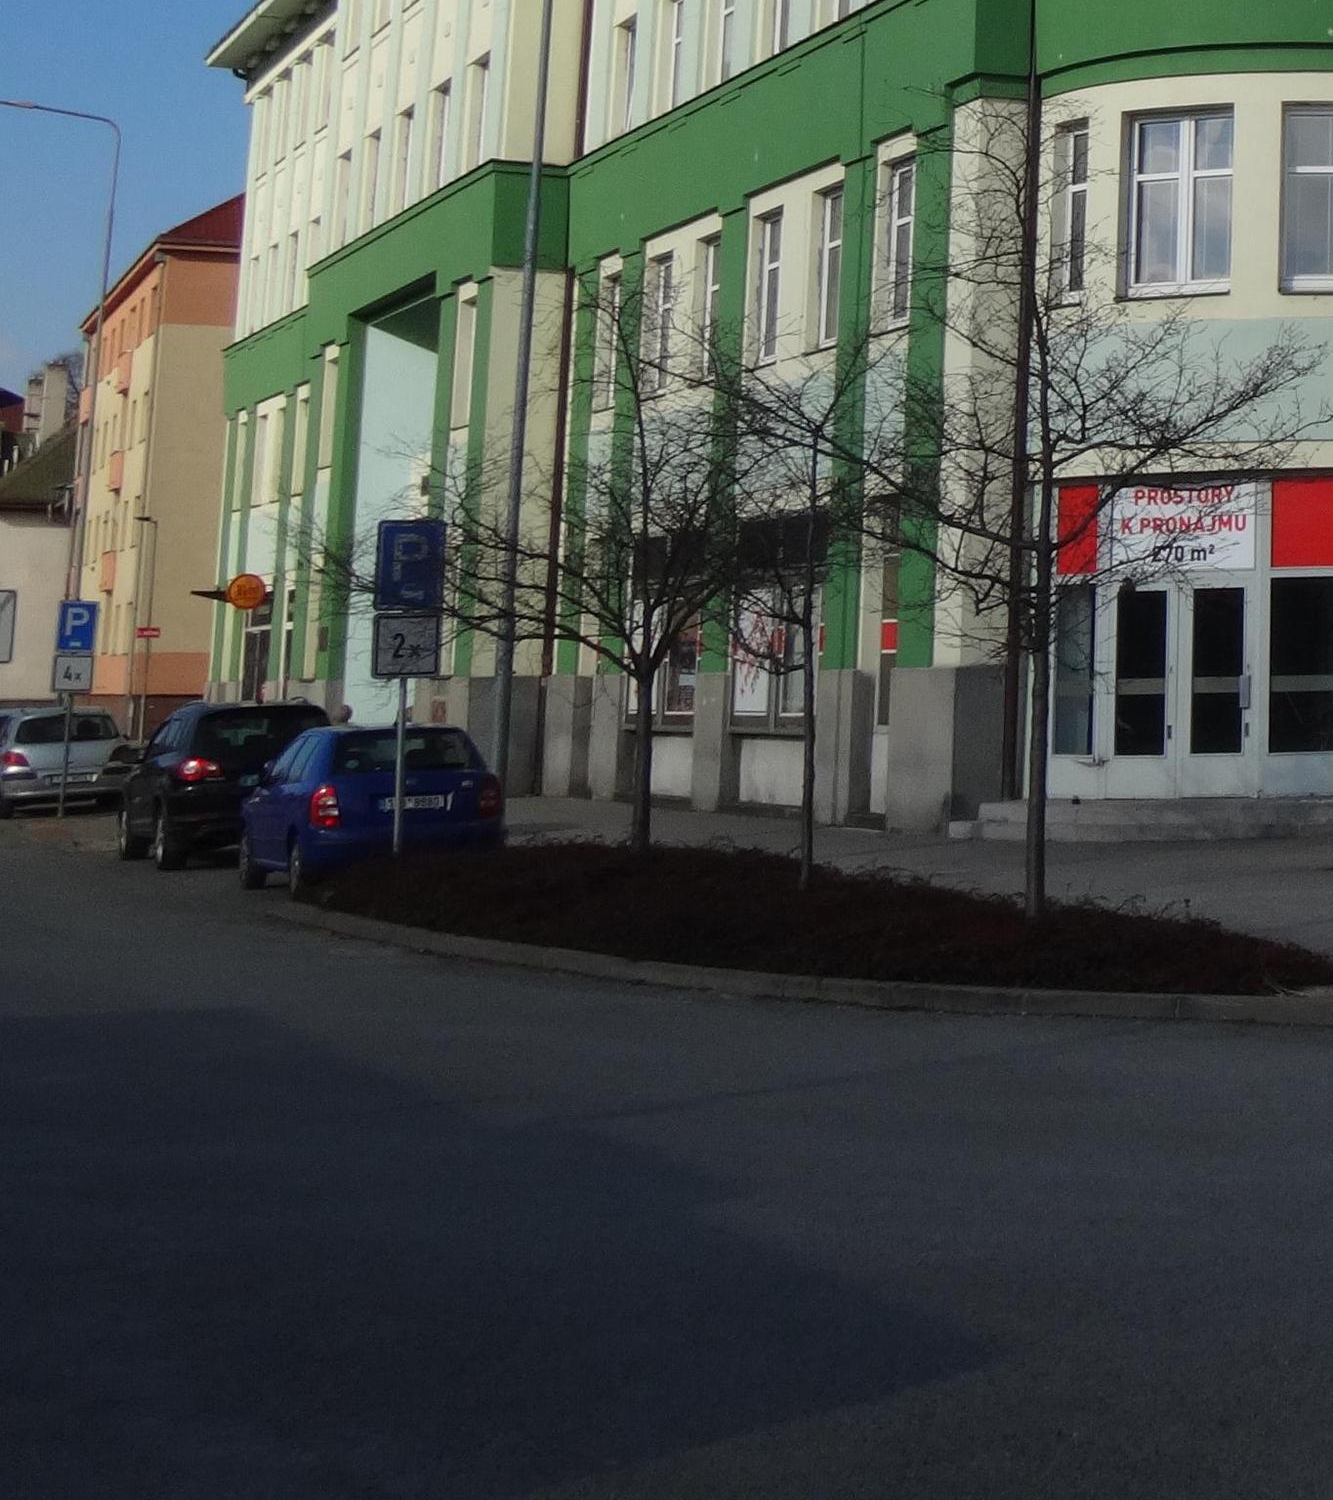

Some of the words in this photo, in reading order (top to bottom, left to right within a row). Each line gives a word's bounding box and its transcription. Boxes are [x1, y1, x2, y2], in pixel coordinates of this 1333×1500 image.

[1134, 486, 1234, 505] PROSTORY
[1120, 517, 1132, 534] K
[1152, 544, 1184, 563] 270
[65, 607, 89, 635] P
[393, 633, 421, 658] 2x
[63, 665, 82, 681] 4x
